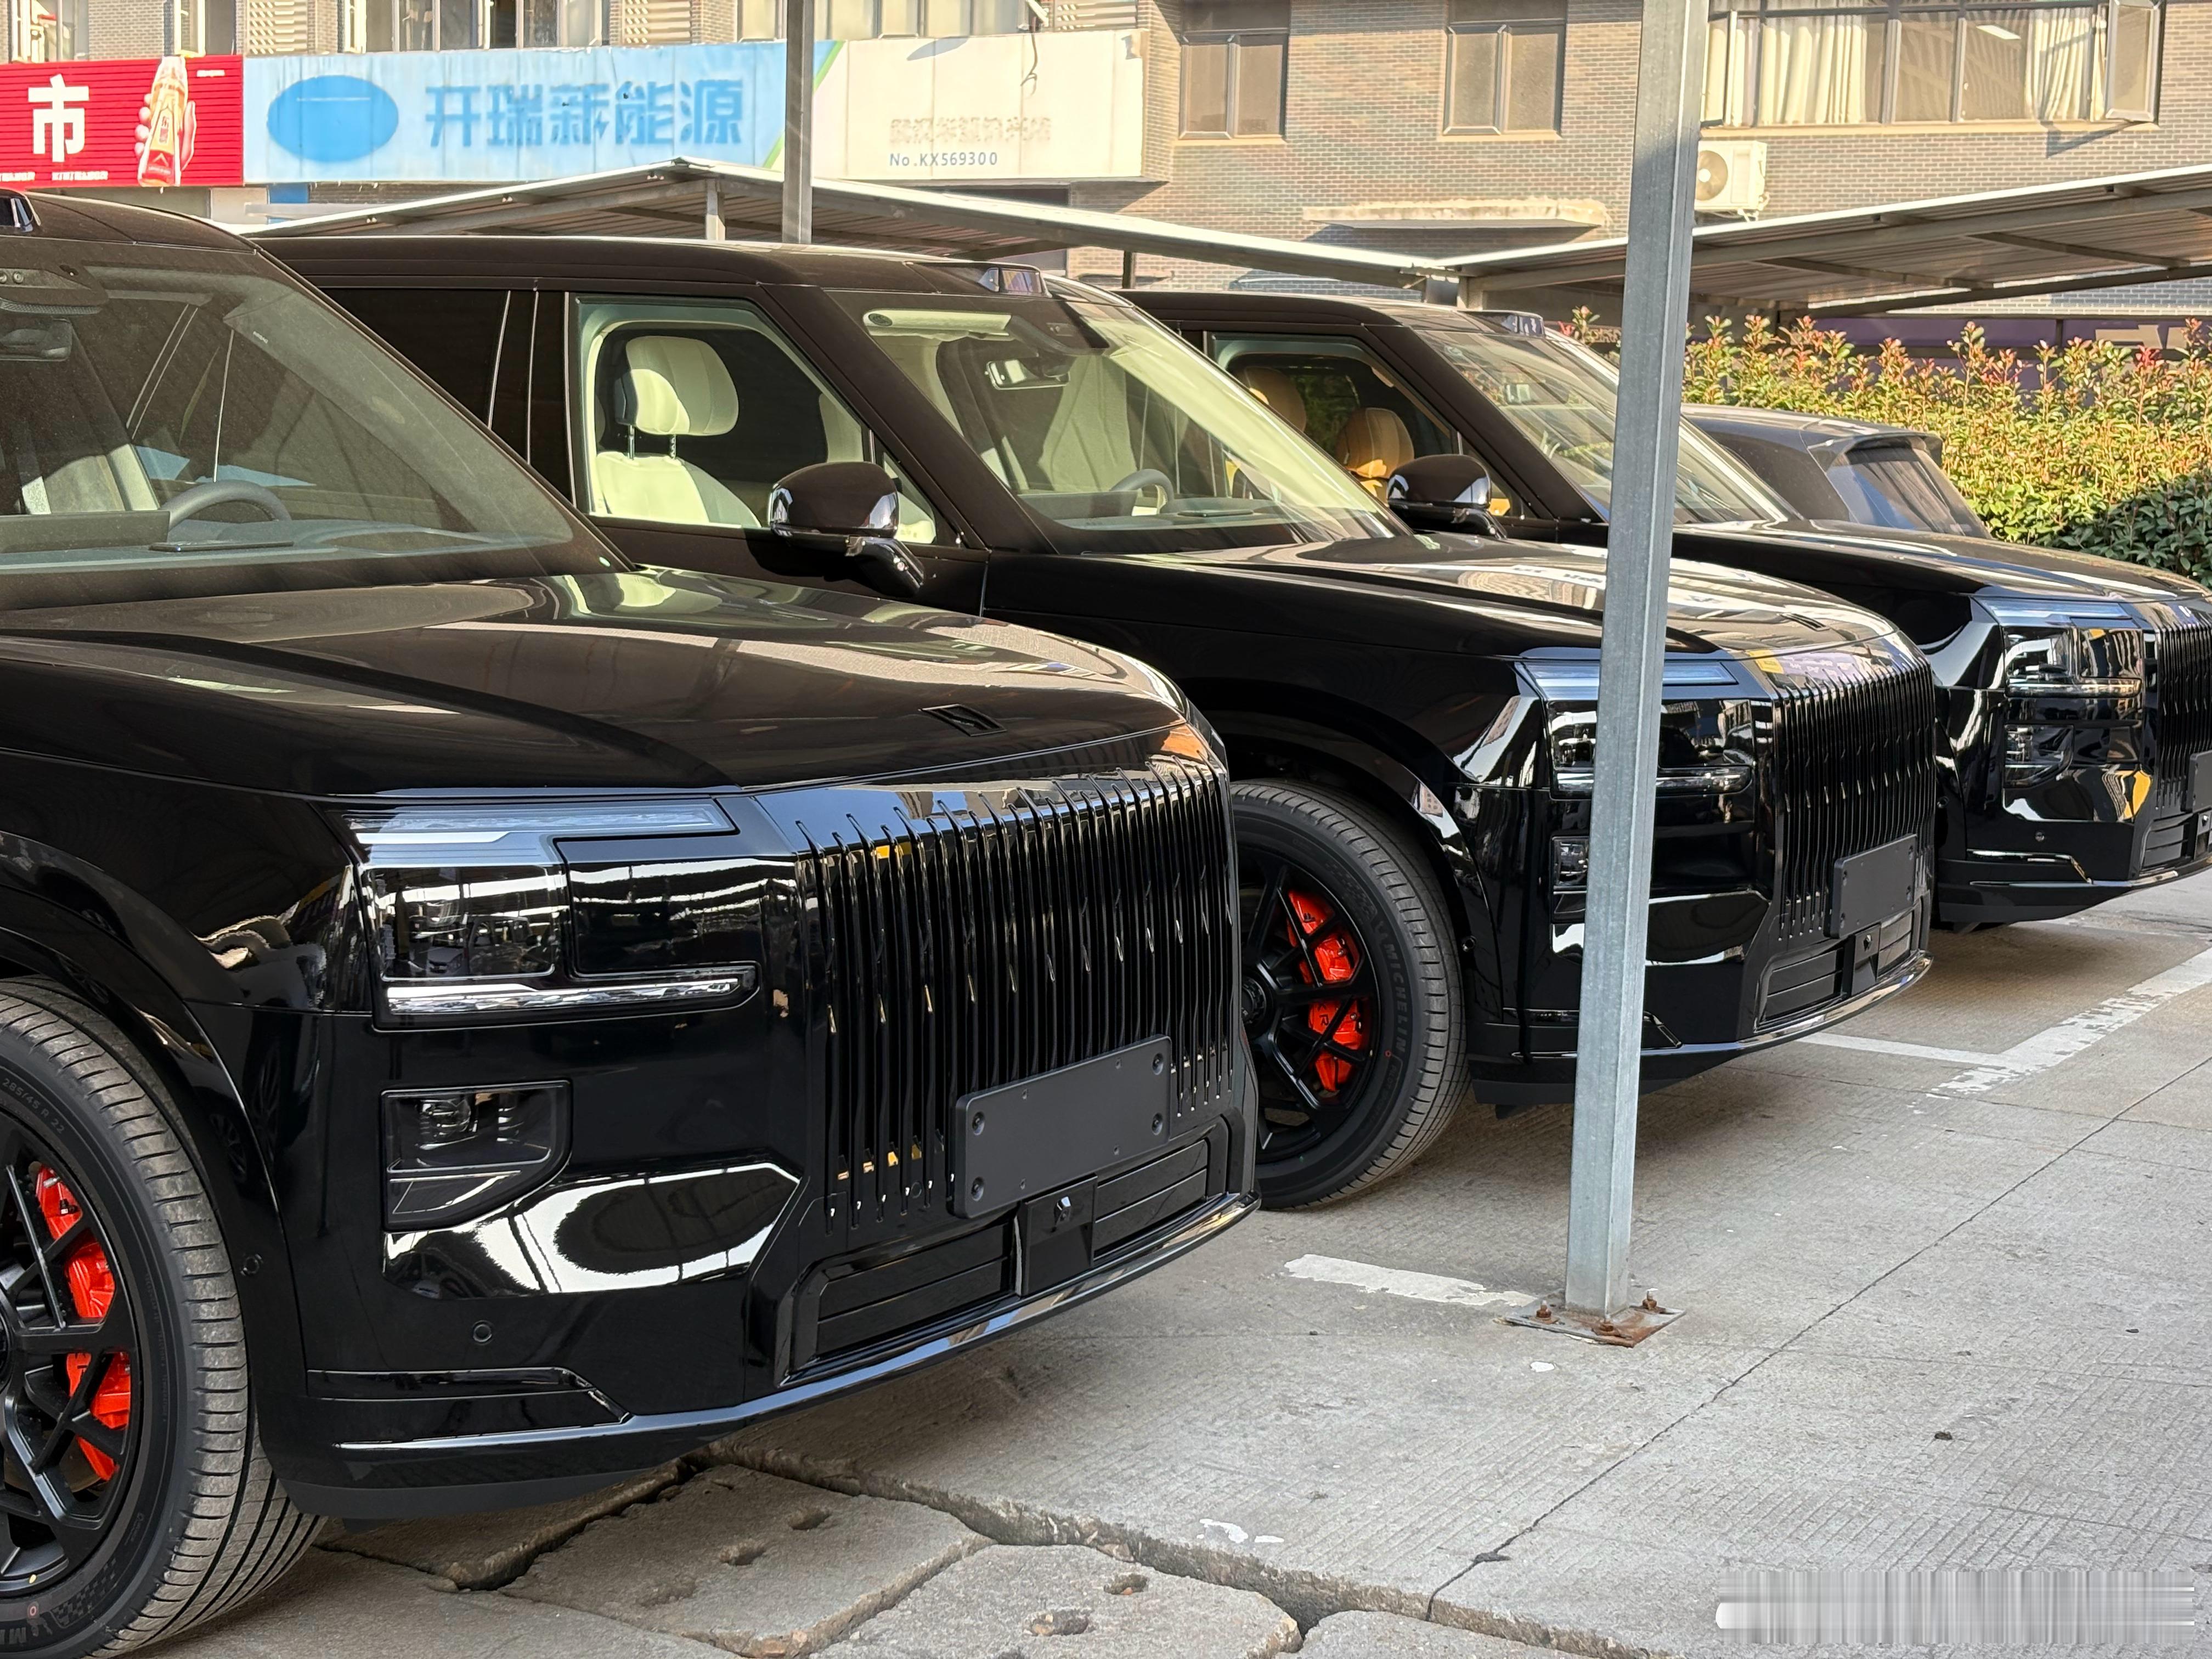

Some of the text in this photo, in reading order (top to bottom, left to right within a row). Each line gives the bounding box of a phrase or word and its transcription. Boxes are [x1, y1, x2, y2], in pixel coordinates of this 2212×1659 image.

[28, 74, 89, 162] 市
[425, 79, 744, 148] 开瑞新能源
[889, 151, 998, 167] No.KX569300
[1384, 943, 1408, 1053] MICHELIN
[2, 1077, 41, 1110] 285/45
[41, 1108, 50, 1119] R
[50, 1118, 65, 1135] 22
